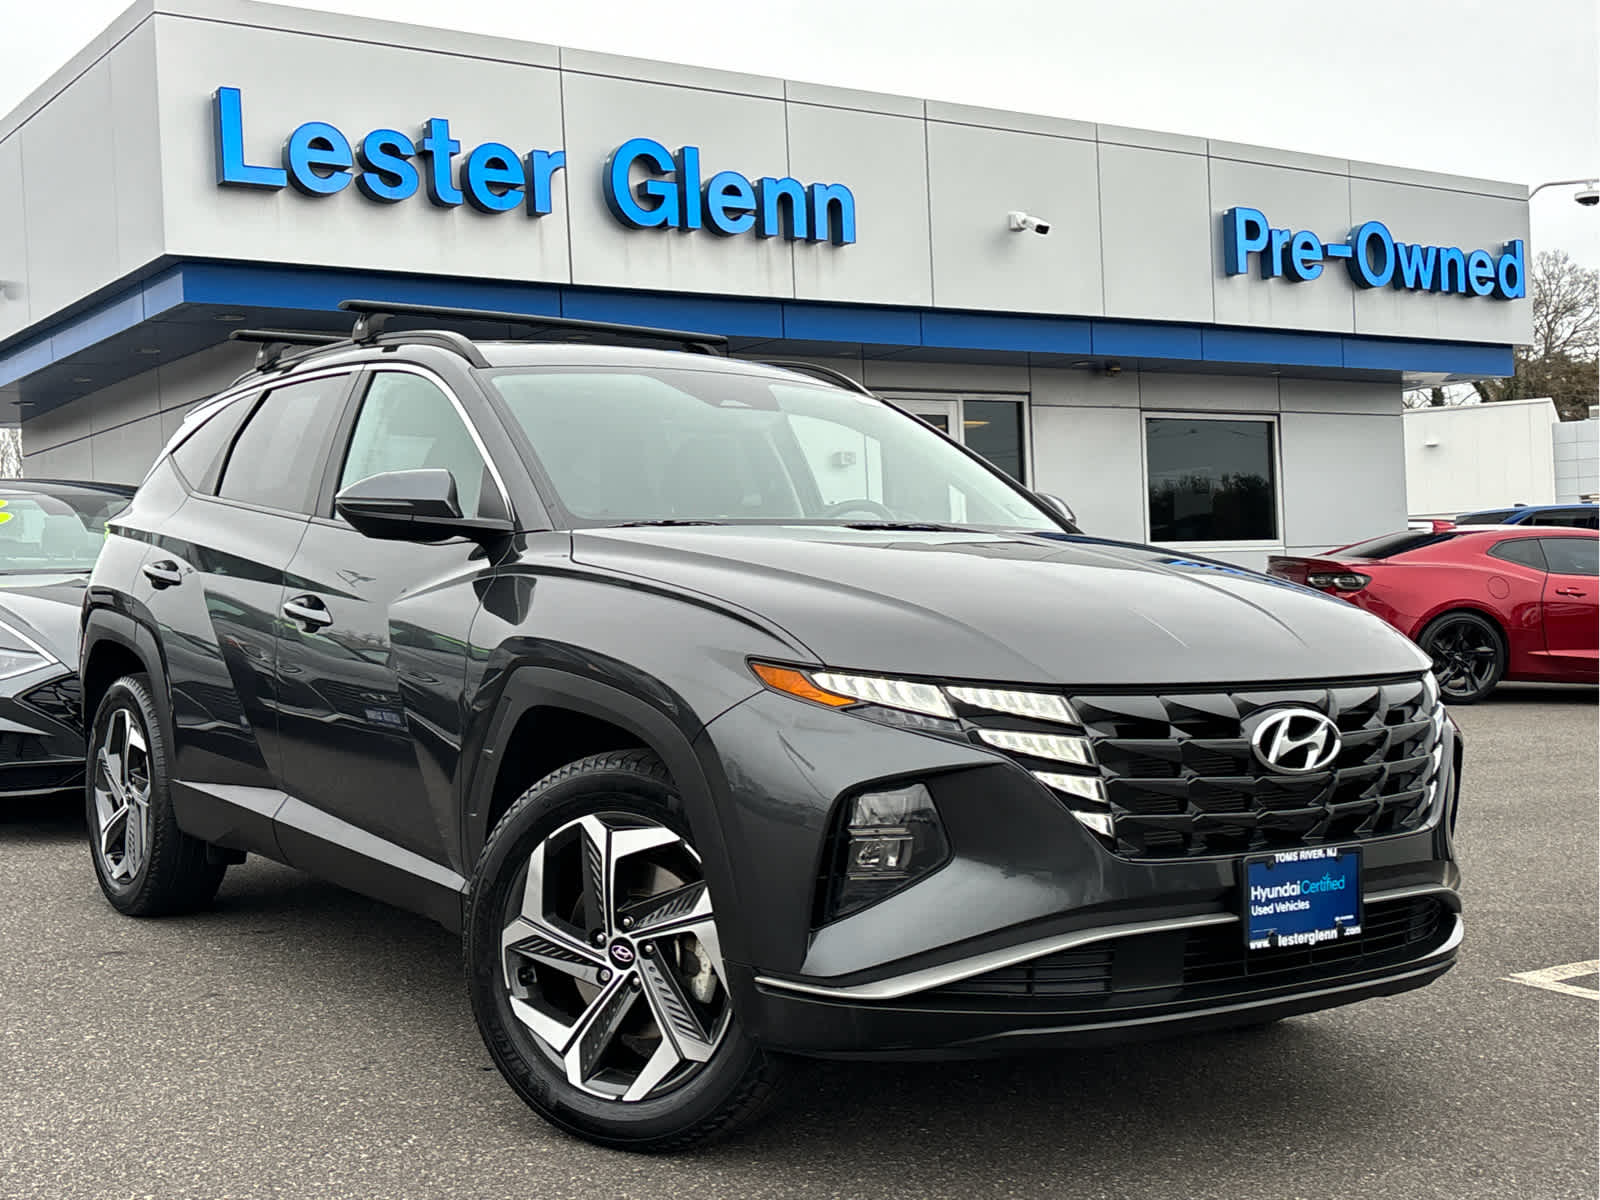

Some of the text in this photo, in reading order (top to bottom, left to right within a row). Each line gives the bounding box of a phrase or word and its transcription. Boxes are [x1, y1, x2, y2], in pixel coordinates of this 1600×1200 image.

[211, 86, 857, 246] Lester Glenn
[1223, 207, 1525, 298] Pre-Owned
[1275, 852, 1298, 863] TOMS
[1327, 848, 1337, 857] NJ
[1250, 873, 1345, 902] Hyundai Certified
[1251, 900, 1311, 917] Used Vehicles
[1278, 929, 1338, 946] lesterglenn
